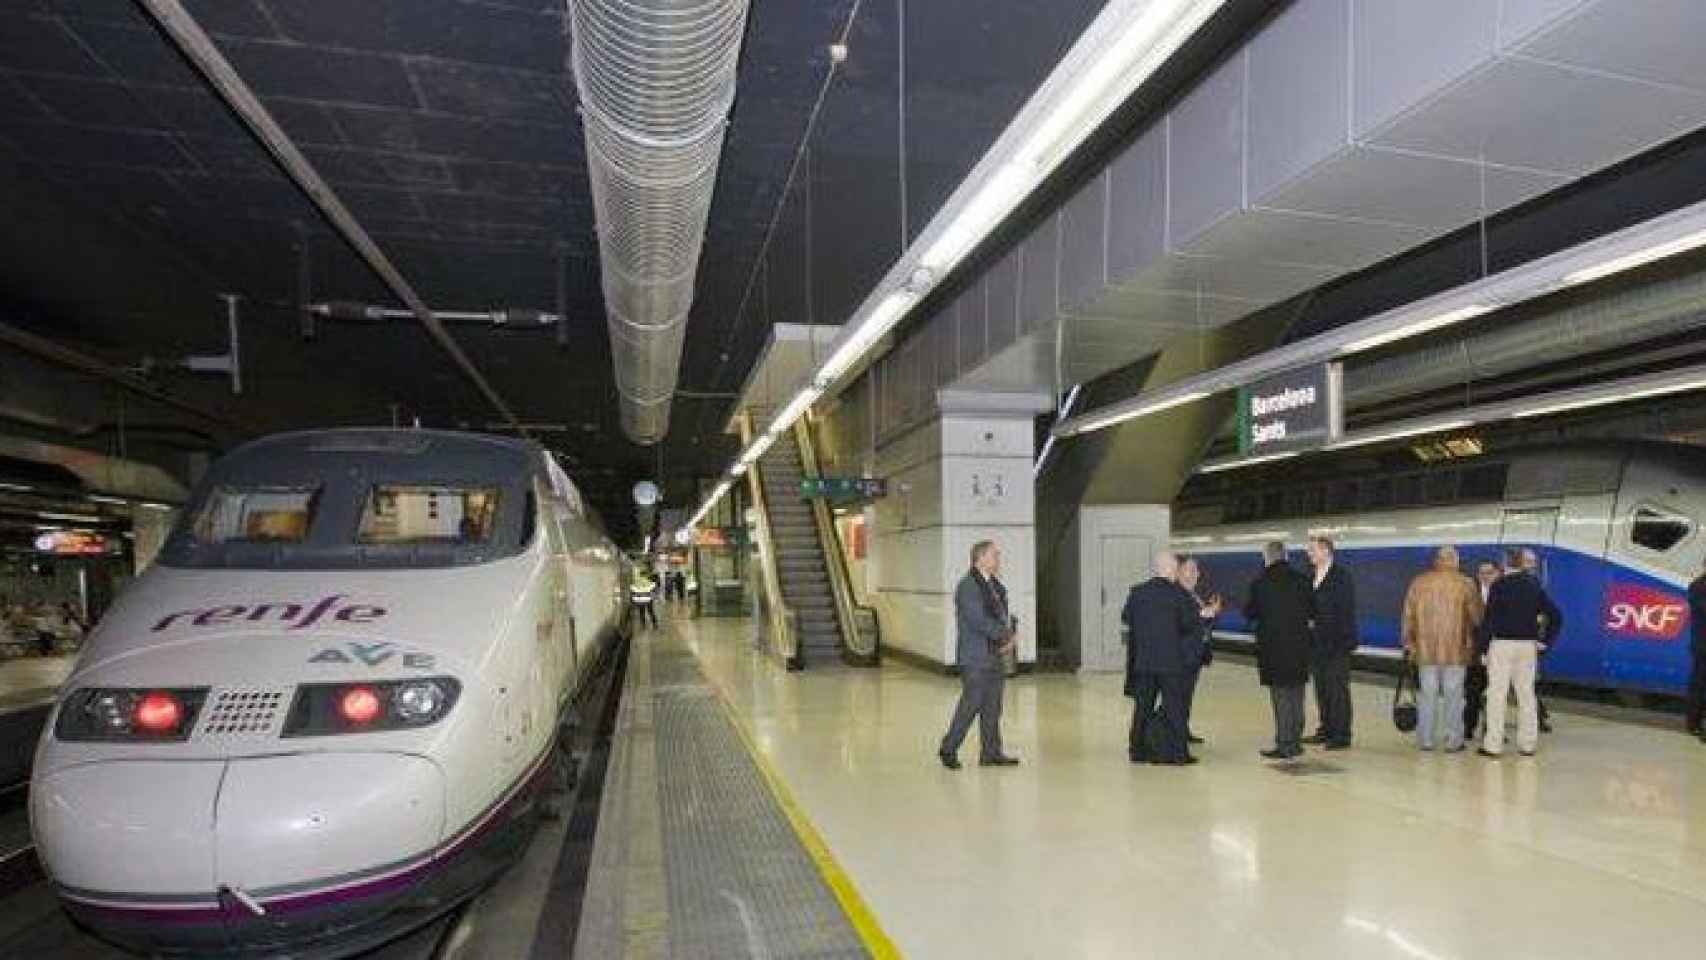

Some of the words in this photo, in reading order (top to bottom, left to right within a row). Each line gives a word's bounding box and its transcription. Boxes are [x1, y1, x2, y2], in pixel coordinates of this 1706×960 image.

[151, 594, 388, 633] renfe
[1607, 603, 1684, 633] SNCF
[307, 642, 434, 668] AVE
